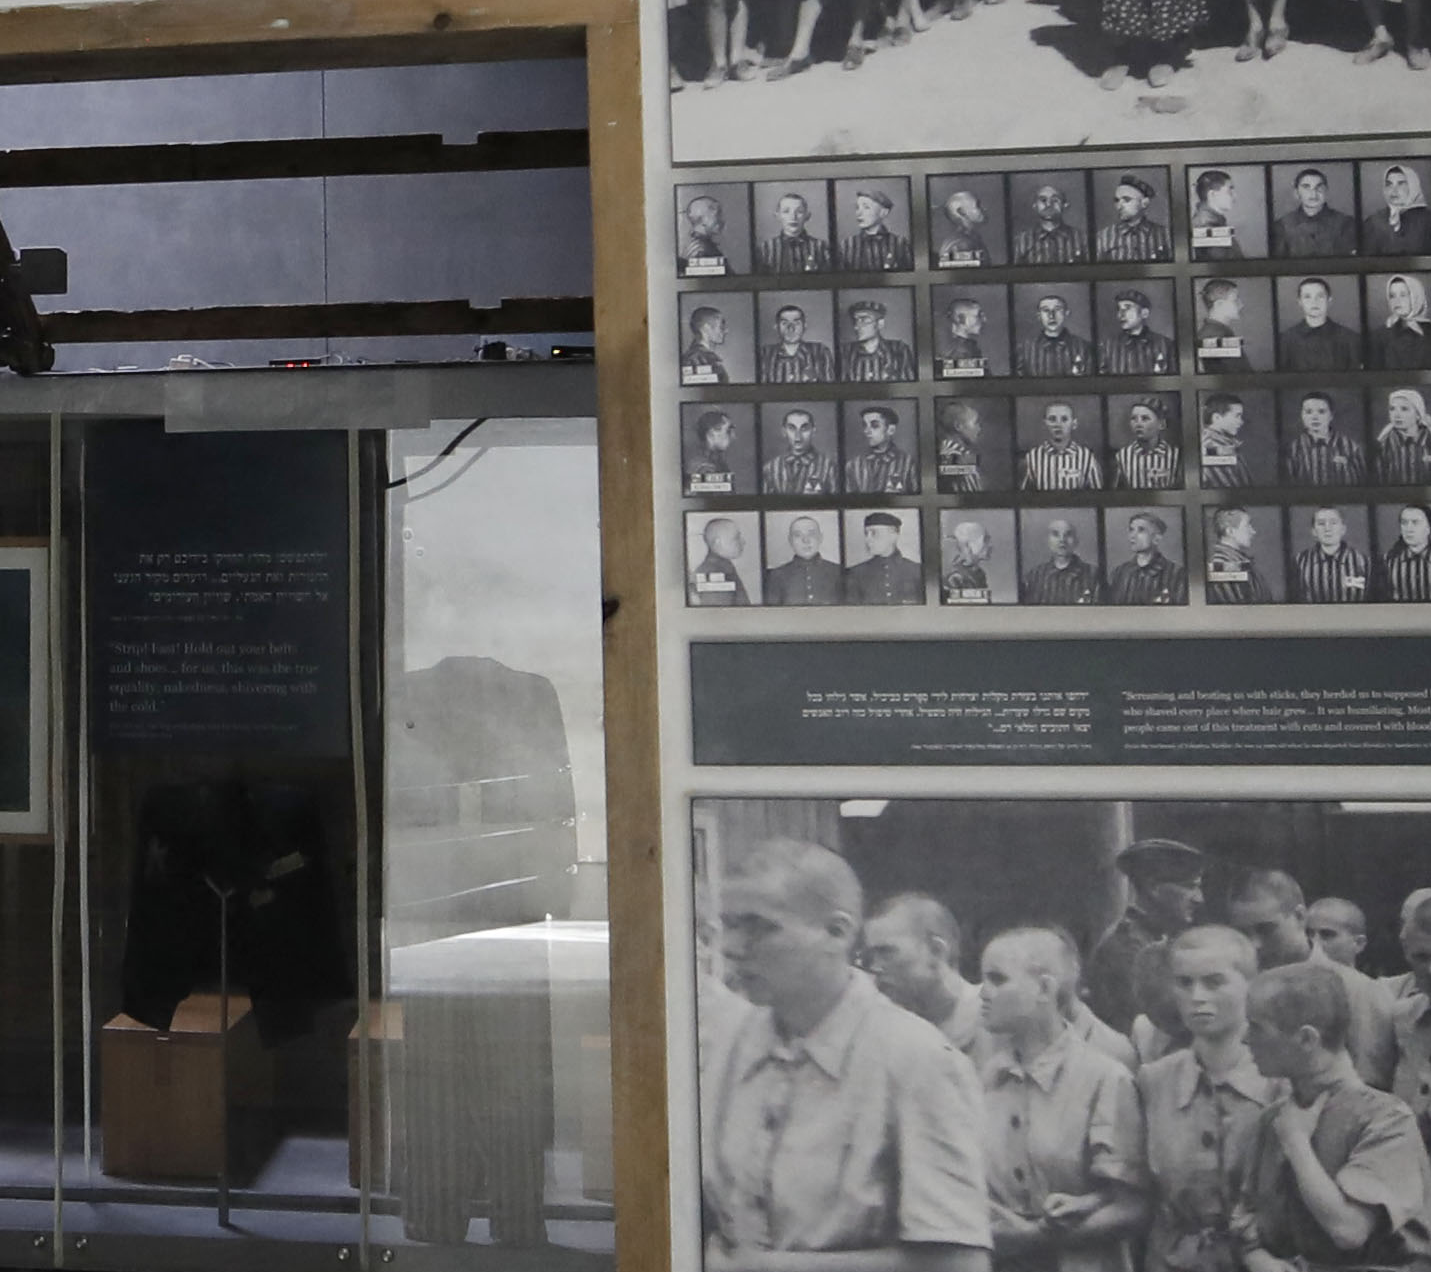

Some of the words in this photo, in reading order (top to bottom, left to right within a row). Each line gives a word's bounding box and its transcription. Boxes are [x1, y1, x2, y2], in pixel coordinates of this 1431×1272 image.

[183, 641, 213, 655] Hold
[215, 643, 236, 655] out
[238, 645, 266, 659] your
[109, 661, 132, 674] and
[181, 661, 198, 674] for
[221, 661, 243, 674] this
[272, 662, 291, 674] the
[231, 682, 288, 697] shivering
[290, 682, 318, 695] with
[1177, 690, 1195, 700] and
[1196, 690, 1232, 703] beating
[1246, 689, 1267, 700] with
[1300, 688, 1320, 702] they
[1322, 688, 1357, 700] herded
[1383, 688, 1428, 702] supposed
[109, 700, 128, 712] the
[1122, 707, 1143, 717] who
[1145, 707, 1177, 717] shaved
[1179, 709, 1203, 720] every
[1204, 707, 1231, 720] place
[1232, 706, 1261, 717] where
[1262, 706, 1282, 717] hair
[1327, 707, 1345, 716] was
[1407, 705, 1431, 716] Most
[1123, 724, 1154, 735] people
[1155, 725, 1181, 733] came
[1182, 724, 1199, 733] out
[1212, 723, 1230, 732] this
[1231, 723, 1278, 733] treatment
[1279, 722, 1301, 732] with
[1324, 722, 1343, 732] and
[1344, 721, 1382, 732] covered
[1383, 721, 1405, 731] with
